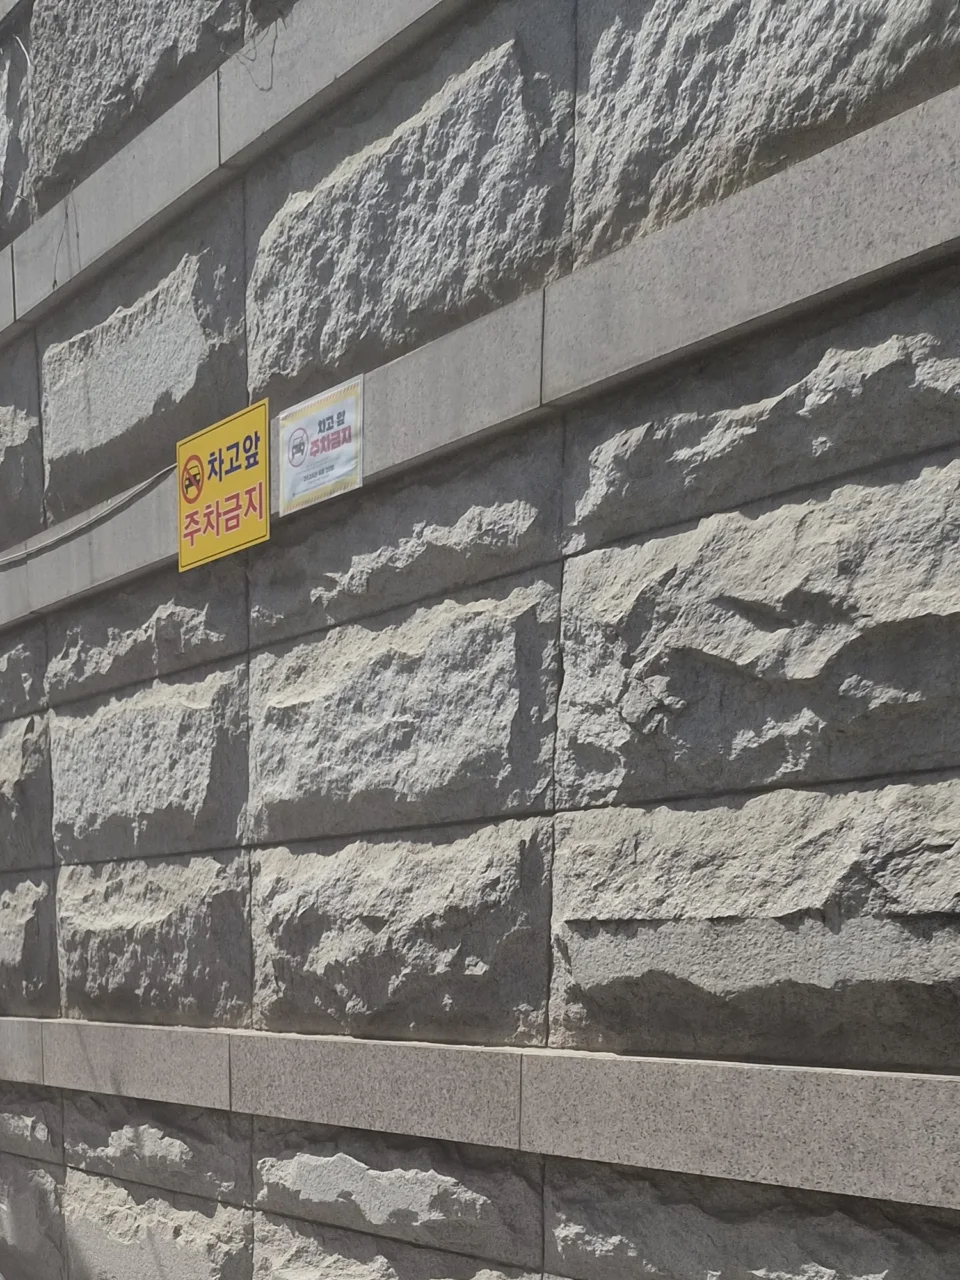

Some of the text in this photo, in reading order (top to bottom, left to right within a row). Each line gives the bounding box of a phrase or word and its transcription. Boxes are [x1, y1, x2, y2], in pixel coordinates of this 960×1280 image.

[309, 425, 352, 457] 주차금지
[317, 415, 334, 435] 차고
[207, 431, 260, 482] 차고앞
[183, 482, 263, 547] 주차금지
